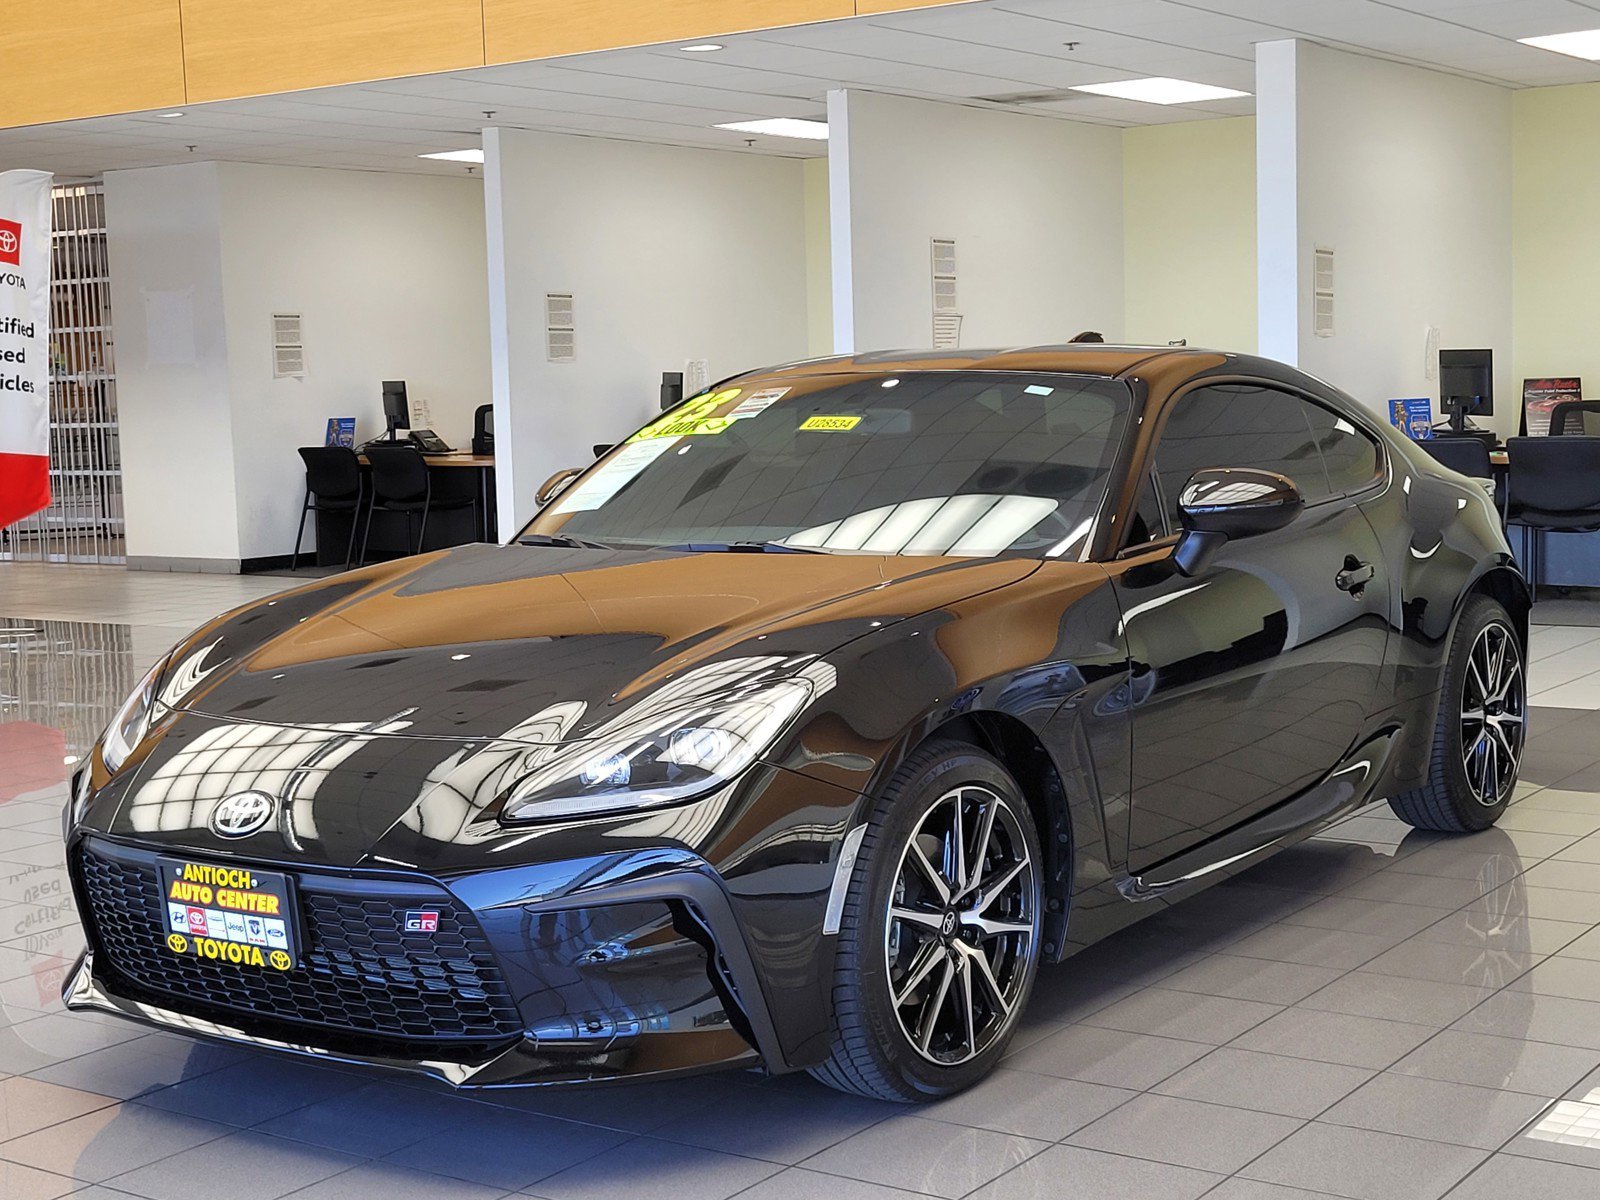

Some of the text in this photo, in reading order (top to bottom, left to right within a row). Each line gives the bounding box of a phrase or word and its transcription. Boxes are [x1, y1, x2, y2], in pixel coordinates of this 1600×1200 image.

[184, 863, 251, 889] ANTIOCH
[170, 881, 280, 914] AUTO CENTER
[407, 919, 436, 930] GR
[194, 937, 265, 967] TOYOTA
